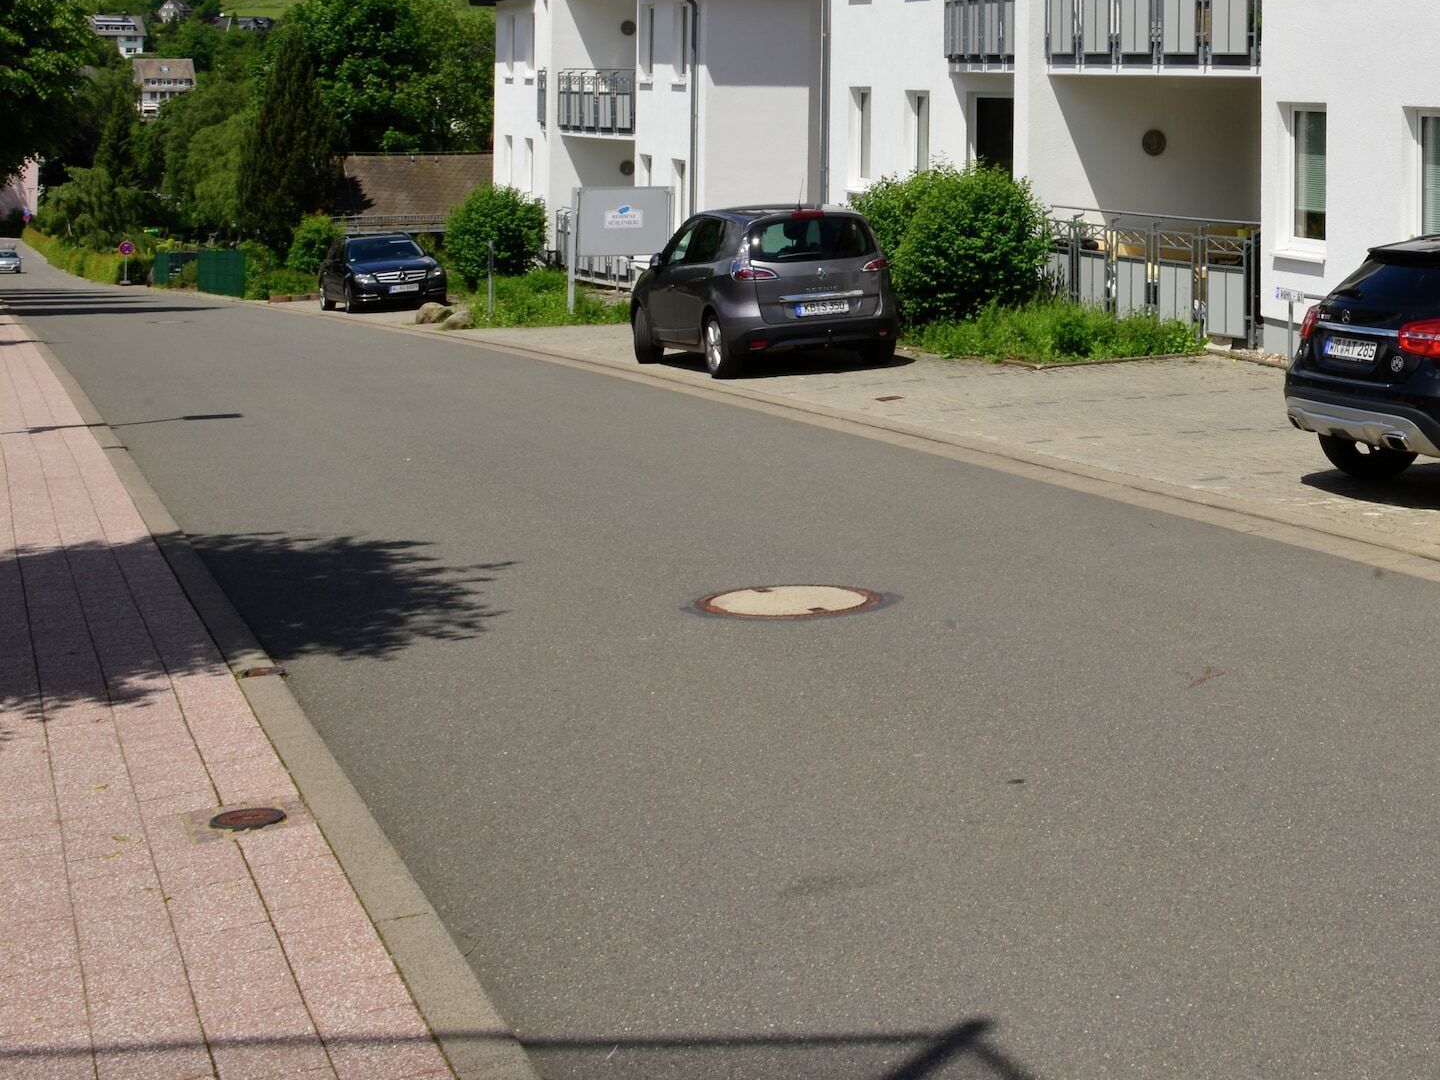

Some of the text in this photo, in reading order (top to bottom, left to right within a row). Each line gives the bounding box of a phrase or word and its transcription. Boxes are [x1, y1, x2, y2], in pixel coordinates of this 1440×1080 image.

[803, 301, 845, 313] KB S 350
[1357, 342, 1376, 358] 285
